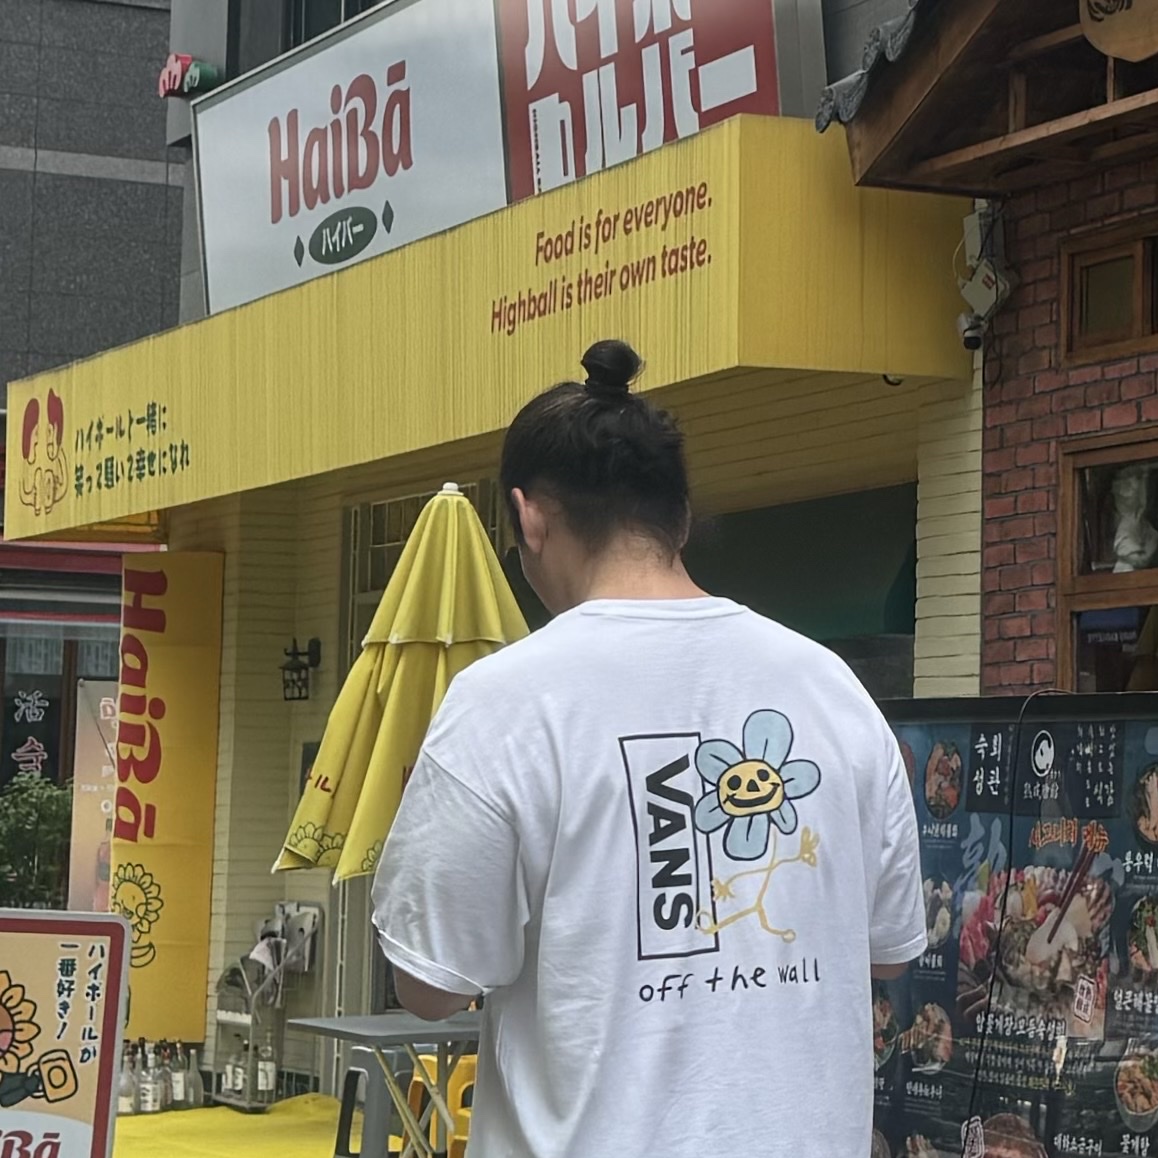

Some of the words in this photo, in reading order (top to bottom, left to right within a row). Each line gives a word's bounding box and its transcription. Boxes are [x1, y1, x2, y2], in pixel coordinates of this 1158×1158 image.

[321, 216, 364, 256] ハイバー
[536, 220, 575, 266] Food
[579, 215, 591, 252] is
[595, 208, 620, 254] for
[623, 182, 712, 237] everyone.
[491, 280, 557, 336] Highball
[561, 276, 573, 311] is
[577, 260, 616, 306] their
[620, 255, 656, 291] own
[661, 235, 711, 278] taste.
[645, 753, 694, 931] VANS
[639, 973, 694, 1002] off
[705, 966, 767, 993] the
[778, 957, 821, 984] wall
